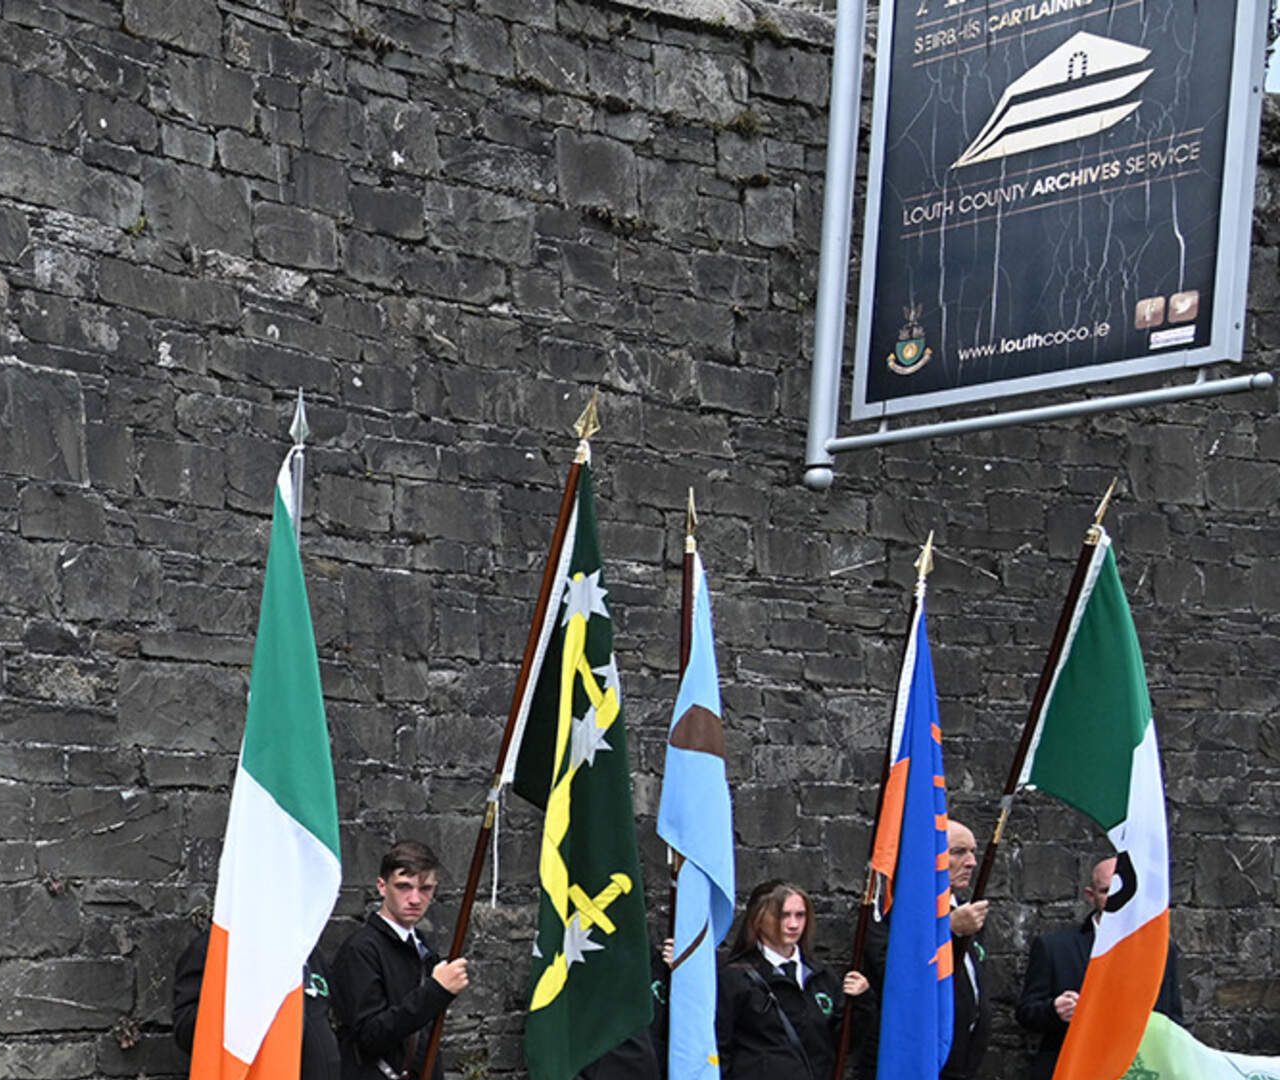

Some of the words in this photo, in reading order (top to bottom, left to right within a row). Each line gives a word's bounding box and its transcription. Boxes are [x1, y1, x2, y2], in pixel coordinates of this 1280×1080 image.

[903, 200, 954, 226] LOUTH
[959, 181, 1030, 213] COUNTY
[1031, 160, 1120, 197] ARCHIVES
[1125, 141, 1200, 175] SERVICE
[958, 321, 1111, 360] www.louthcoco.ie
